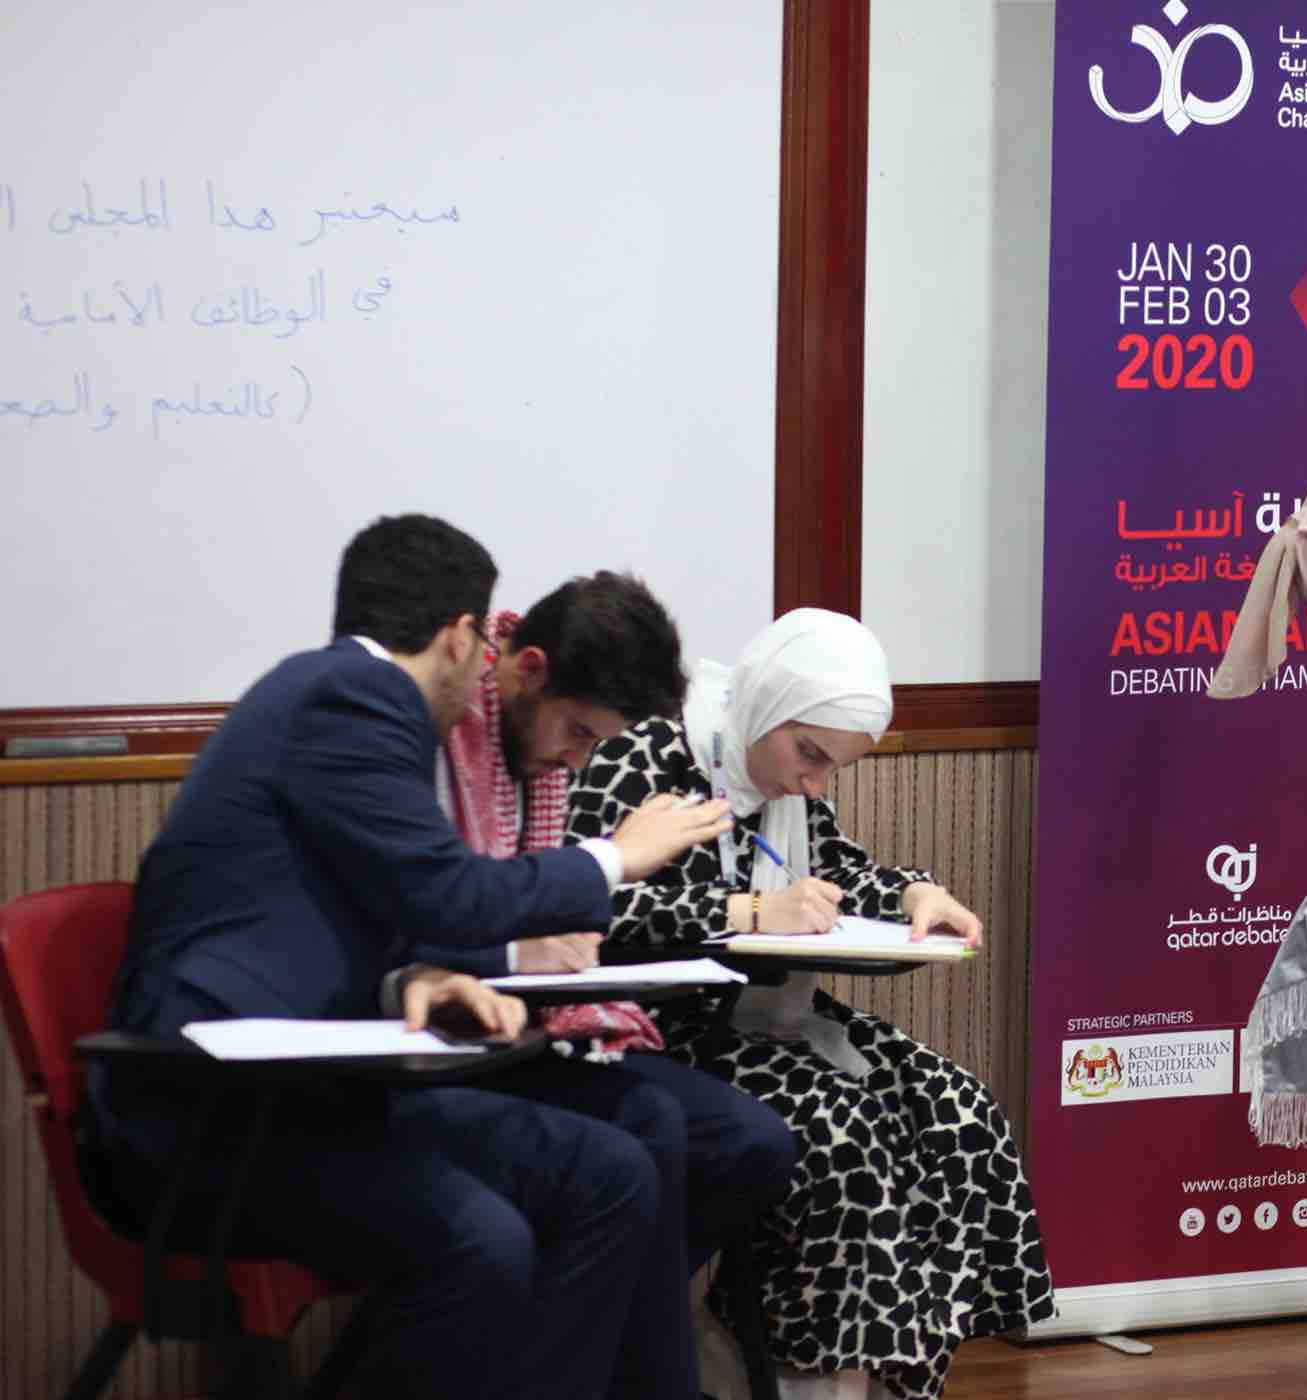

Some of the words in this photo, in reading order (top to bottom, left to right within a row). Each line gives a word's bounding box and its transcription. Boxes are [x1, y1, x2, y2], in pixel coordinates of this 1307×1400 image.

[1117, 242, 1193, 281] JAN
[1205, 244, 1252, 282] 30
[1119, 286, 1190, 325] FEB
[1204, 287, 1251, 326] 03
[1116, 333, 1254, 390] 2020
[1115, 554, 1207, 592] العربية
[1110, 667, 1214, 696] DEBATIN
[1167, 907, 1218, 929] قطر
[1221, 905, 1292, 925] مناظرات
[1067, 1014, 1131, 1032] STRATEGIC
[1133, 1010, 1194, 1027] PARTNERS
[1127, 1040, 1232, 1060] KEMENTERIAN
[1127, 1055, 1217, 1074] PENDIDIKAN
[1127, 1071, 1194, 1089] MALAYSIA
